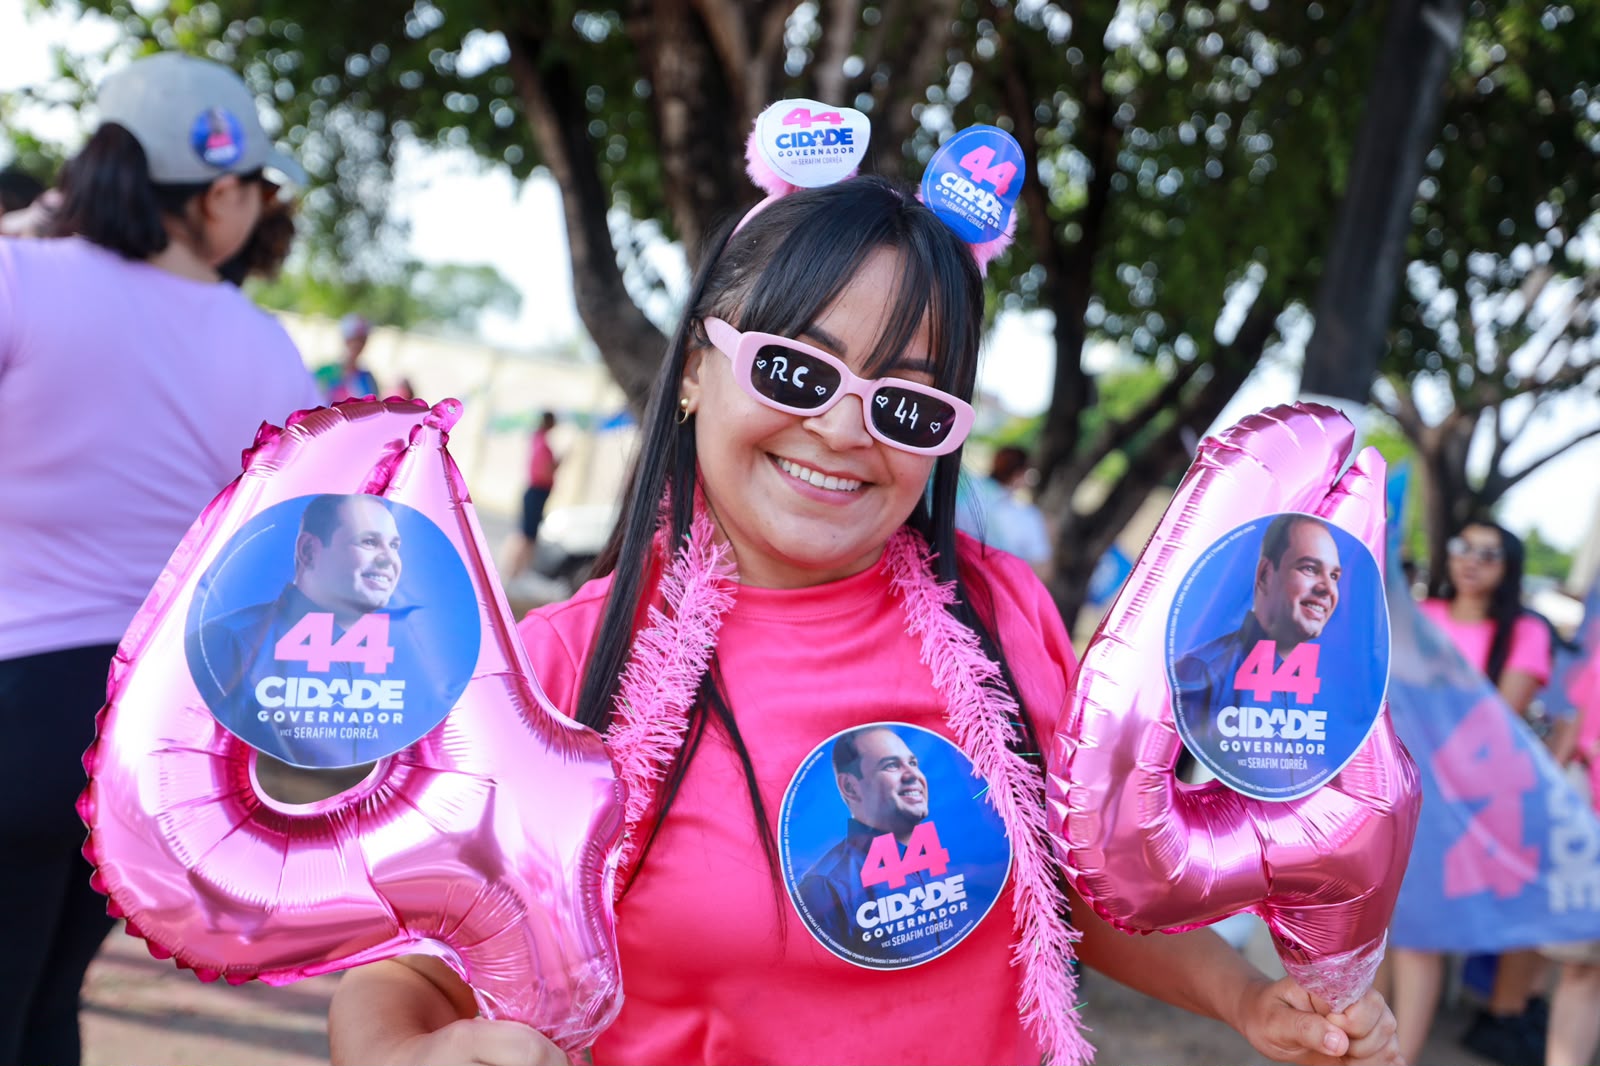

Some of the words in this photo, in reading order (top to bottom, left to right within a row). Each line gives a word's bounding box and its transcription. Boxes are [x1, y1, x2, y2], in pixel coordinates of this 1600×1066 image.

[782, 108, 845, 128] 44
[775, 128, 854, 149] CIDADE
[778, 147, 855, 157] GOVERNADOR
[959, 145, 1018, 198] 44
[935, 184, 1000, 229] GOVERNADOR
[940, 172, 1003, 222] CIDADE
[770, 356, 809, 389] RC
[894, 397, 919, 430] 44
[274, 612, 395, 674] 44
[1233, 640, 1321, 704] 44
[255, 676, 406, 710] CIDADE
[257, 710, 404, 724] GOVERNADOR
[293, 727, 337, 739] SERAFIM
[339, 725, 379, 739] CORRÊA
[1216, 706, 1328, 741] CIDADE
[1219, 740, 1326, 755] GOVERNADOR
[1247, 758, 1279, 769] SERAFIM
[1280, 756, 1308, 770] CORRÊA
[860, 820, 951, 890] 44
[855, 873, 967, 929] CIDADE
[862, 901, 969, 942] GOVERNADOR
[891, 929, 924, 947] SERAFIM
[925, 918, 953, 936] CORRÊA
